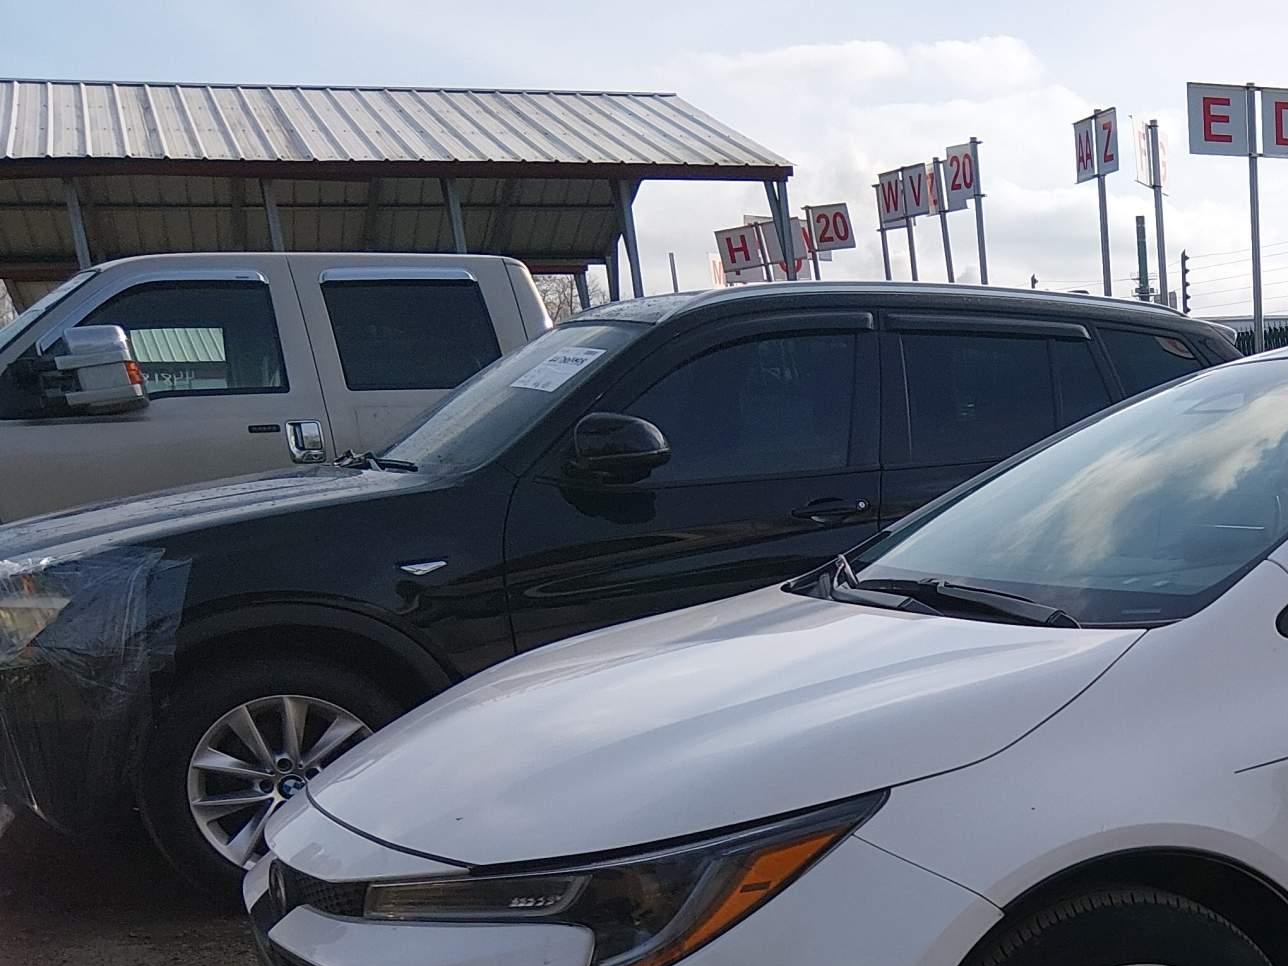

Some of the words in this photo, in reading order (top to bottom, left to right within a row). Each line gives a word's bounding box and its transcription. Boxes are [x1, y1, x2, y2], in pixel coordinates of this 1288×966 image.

[1203, 97, 1232, 143] E
[1079, 130, 1093, 172] AA
[1103, 121, 1114, 163] Z
[909, 173, 922, 207] V
[949, 153, 974, 191] 20
[882, 179, 899, 214] W
[816, 211, 849, 243] 20
[725, 234, 750, 264] H
